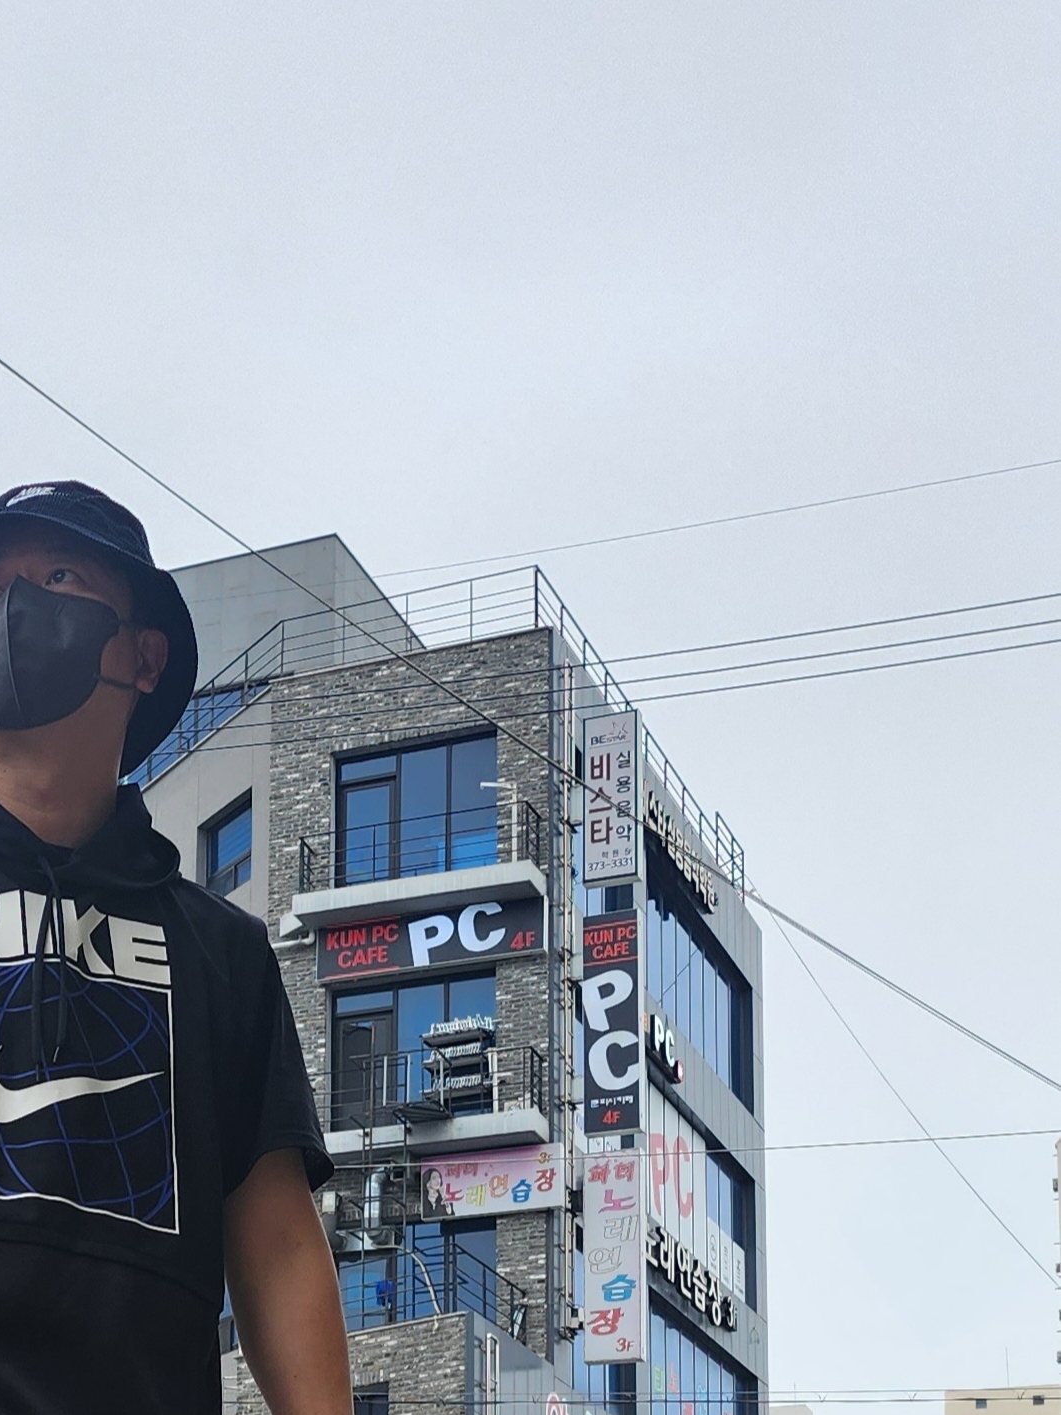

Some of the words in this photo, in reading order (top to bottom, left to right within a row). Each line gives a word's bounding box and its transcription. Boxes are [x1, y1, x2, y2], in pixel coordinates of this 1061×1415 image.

[589, 753, 614, 846] 비스타
[615, 750, 633, 842] 실용음악
[587, 856, 634, 872] 373-3331
[326, 926, 367, 951] KUN
[371, 923, 400, 943] PC
[337, 945, 389, 969] CAFE
[407, 901, 507, 968] PC
[510, 930, 536, 950] 4F
[584, 929, 614, 947] KUN
[617, 925, 637, 939] PC
[591, 941, 630, 959] CAFE
[577, 969, 640, 1091] PC
[654, 1013, 675, 1068] PC
[602, 1109, 621, 1125] 4F
[443, 1167, 557, 1207] 노래연습장
[649, 1132, 694, 1219] PC
[586, 1188, 639, 1337] 노래연습장
[645, 1226, 723, 1327] 노래연습장
[615, 1337, 635, 1354] 3F
